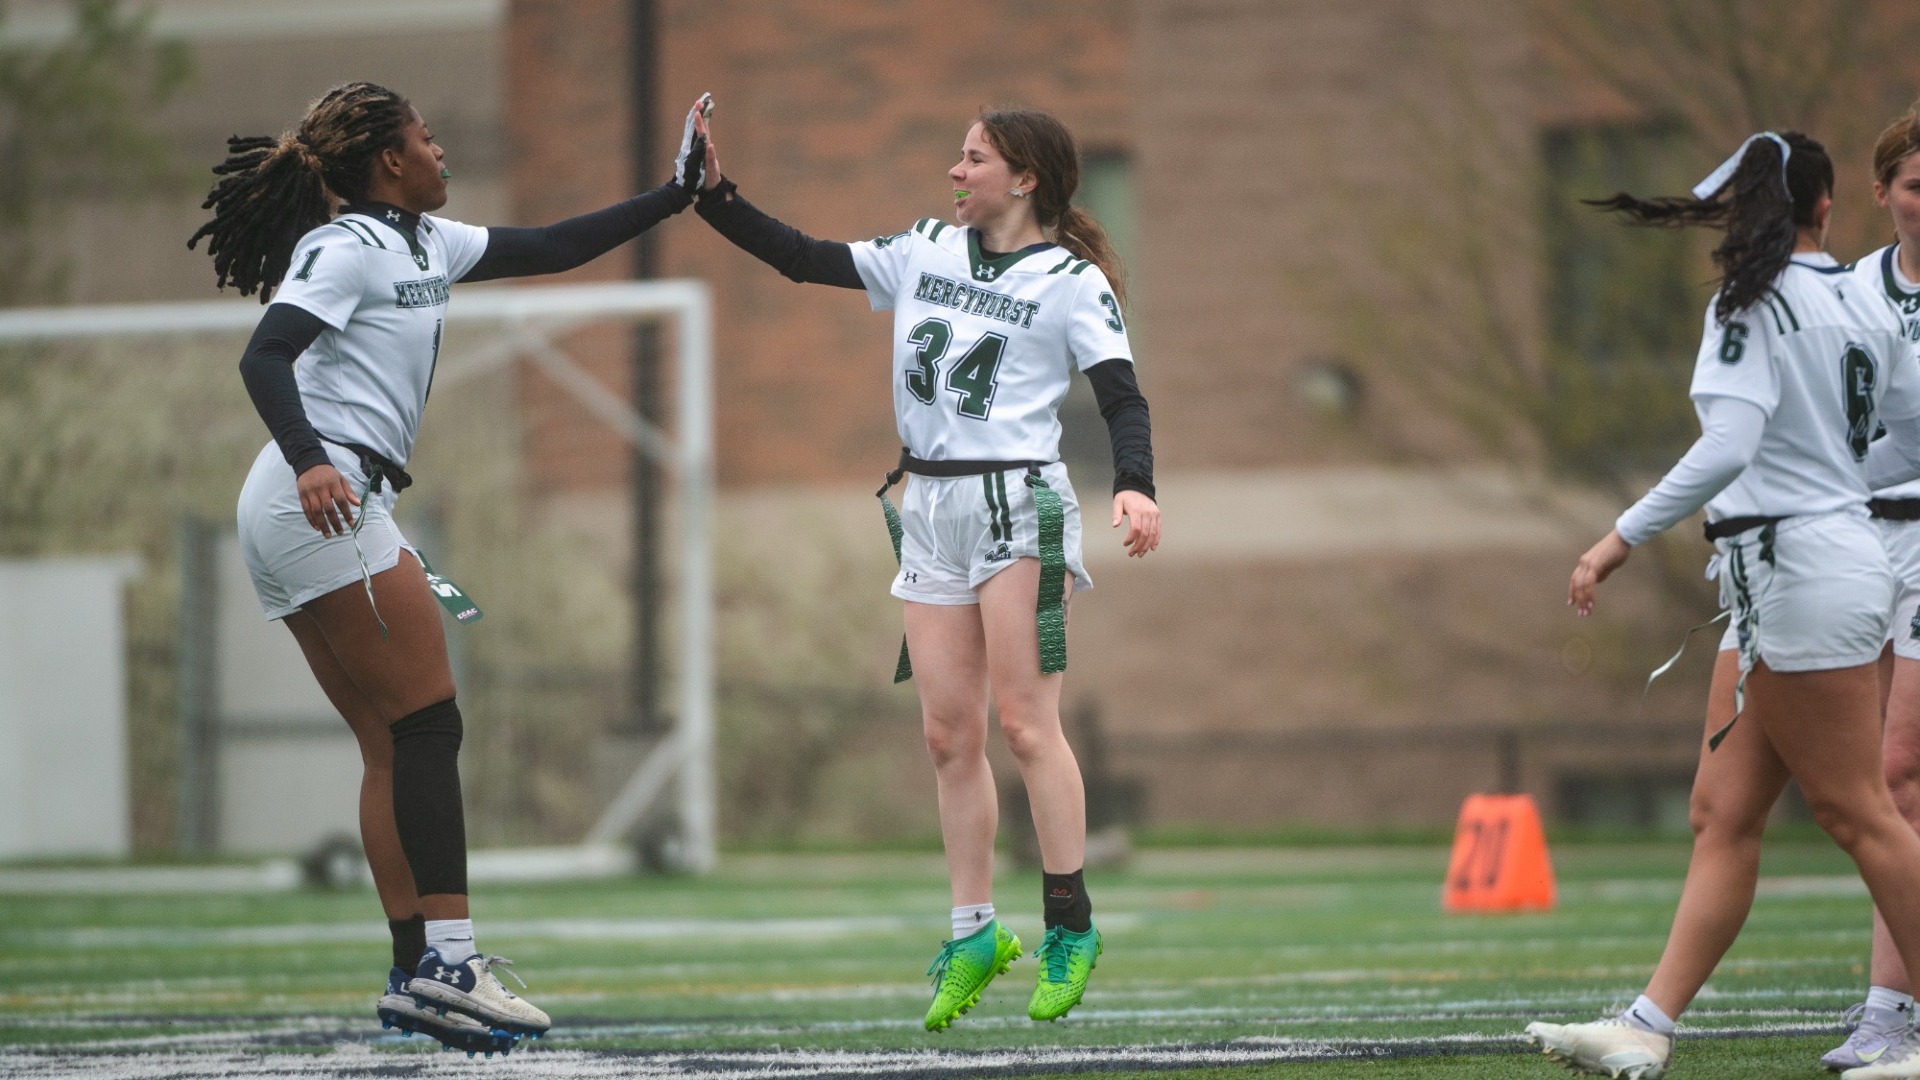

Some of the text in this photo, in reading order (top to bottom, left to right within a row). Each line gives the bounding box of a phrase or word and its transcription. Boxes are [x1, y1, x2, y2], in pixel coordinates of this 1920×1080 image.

[292, 246, 325, 283] 1
[914, 271, 1040, 329] MERCYHURST
[905, 316, 1008, 421] 34
[1718, 320, 1749, 367] 6
[1841, 341, 1878, 463] 6
